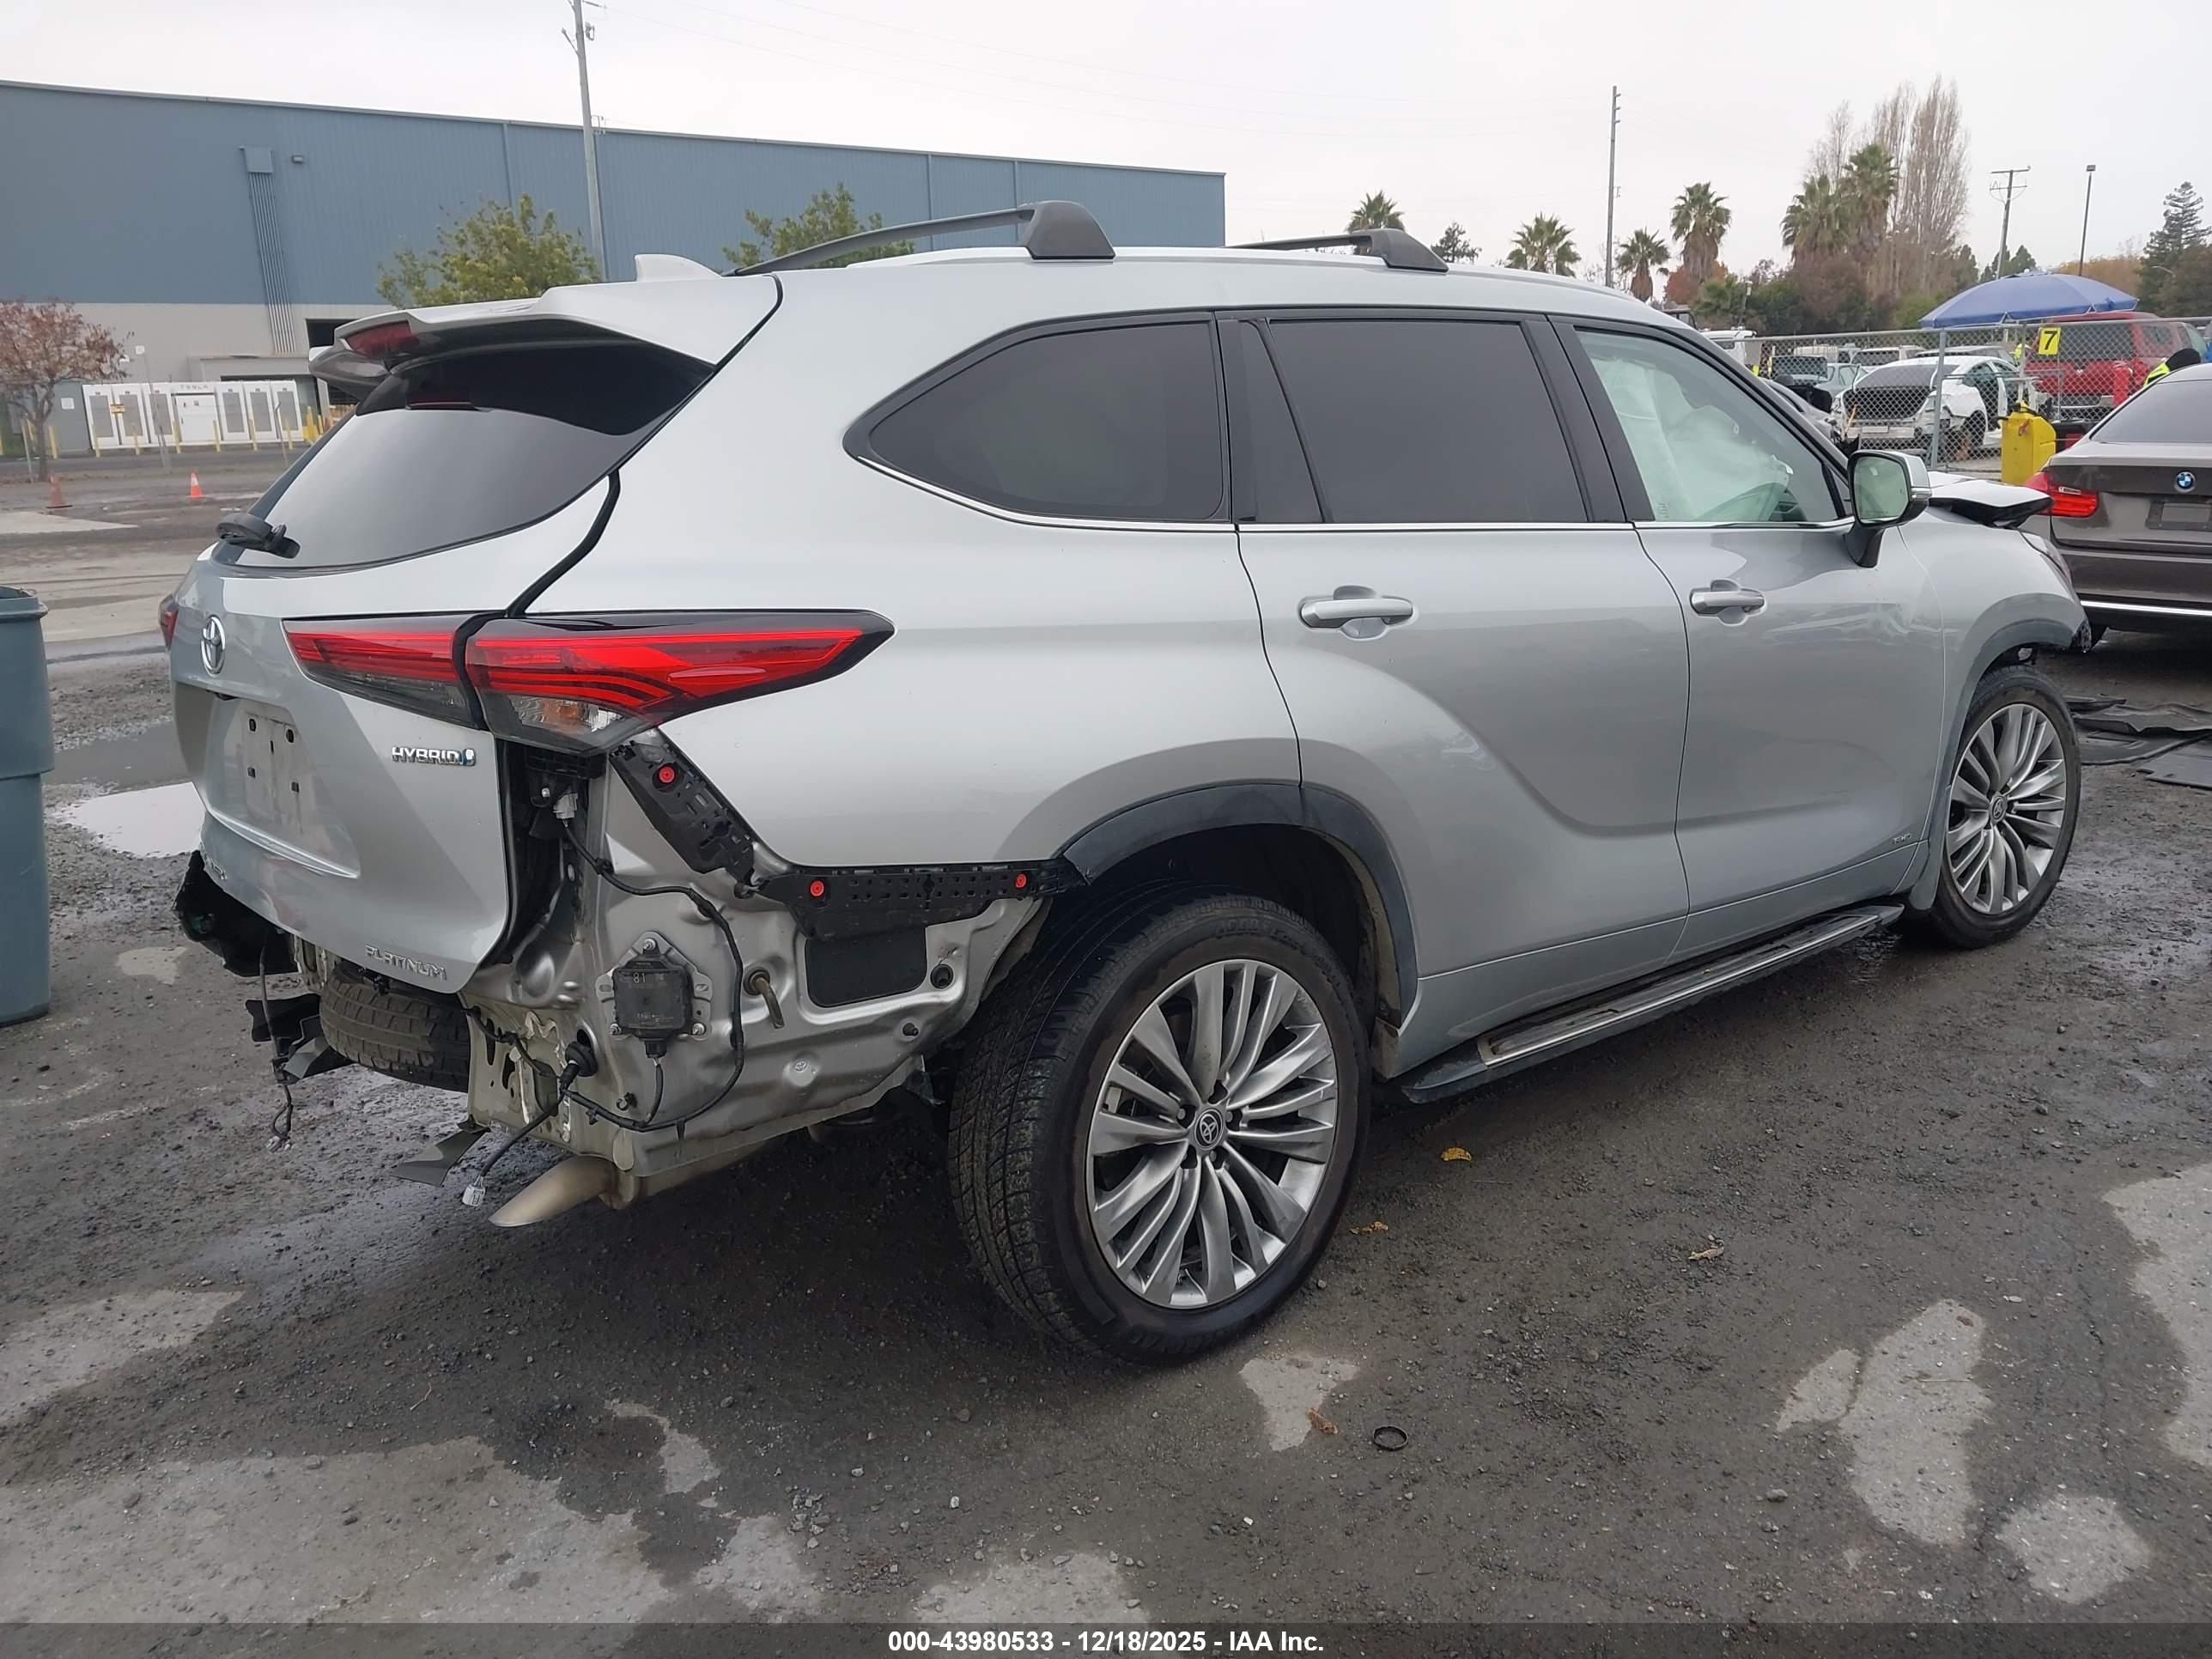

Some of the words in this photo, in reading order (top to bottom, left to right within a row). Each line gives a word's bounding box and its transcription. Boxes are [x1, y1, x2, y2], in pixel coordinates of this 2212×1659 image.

[2044, 330, 2058, 350] 7
[392, 746, 463, 765] HYBRID
[364, 944, 447, 981] PLATINUM
[633, 972, 646, 983] 81
